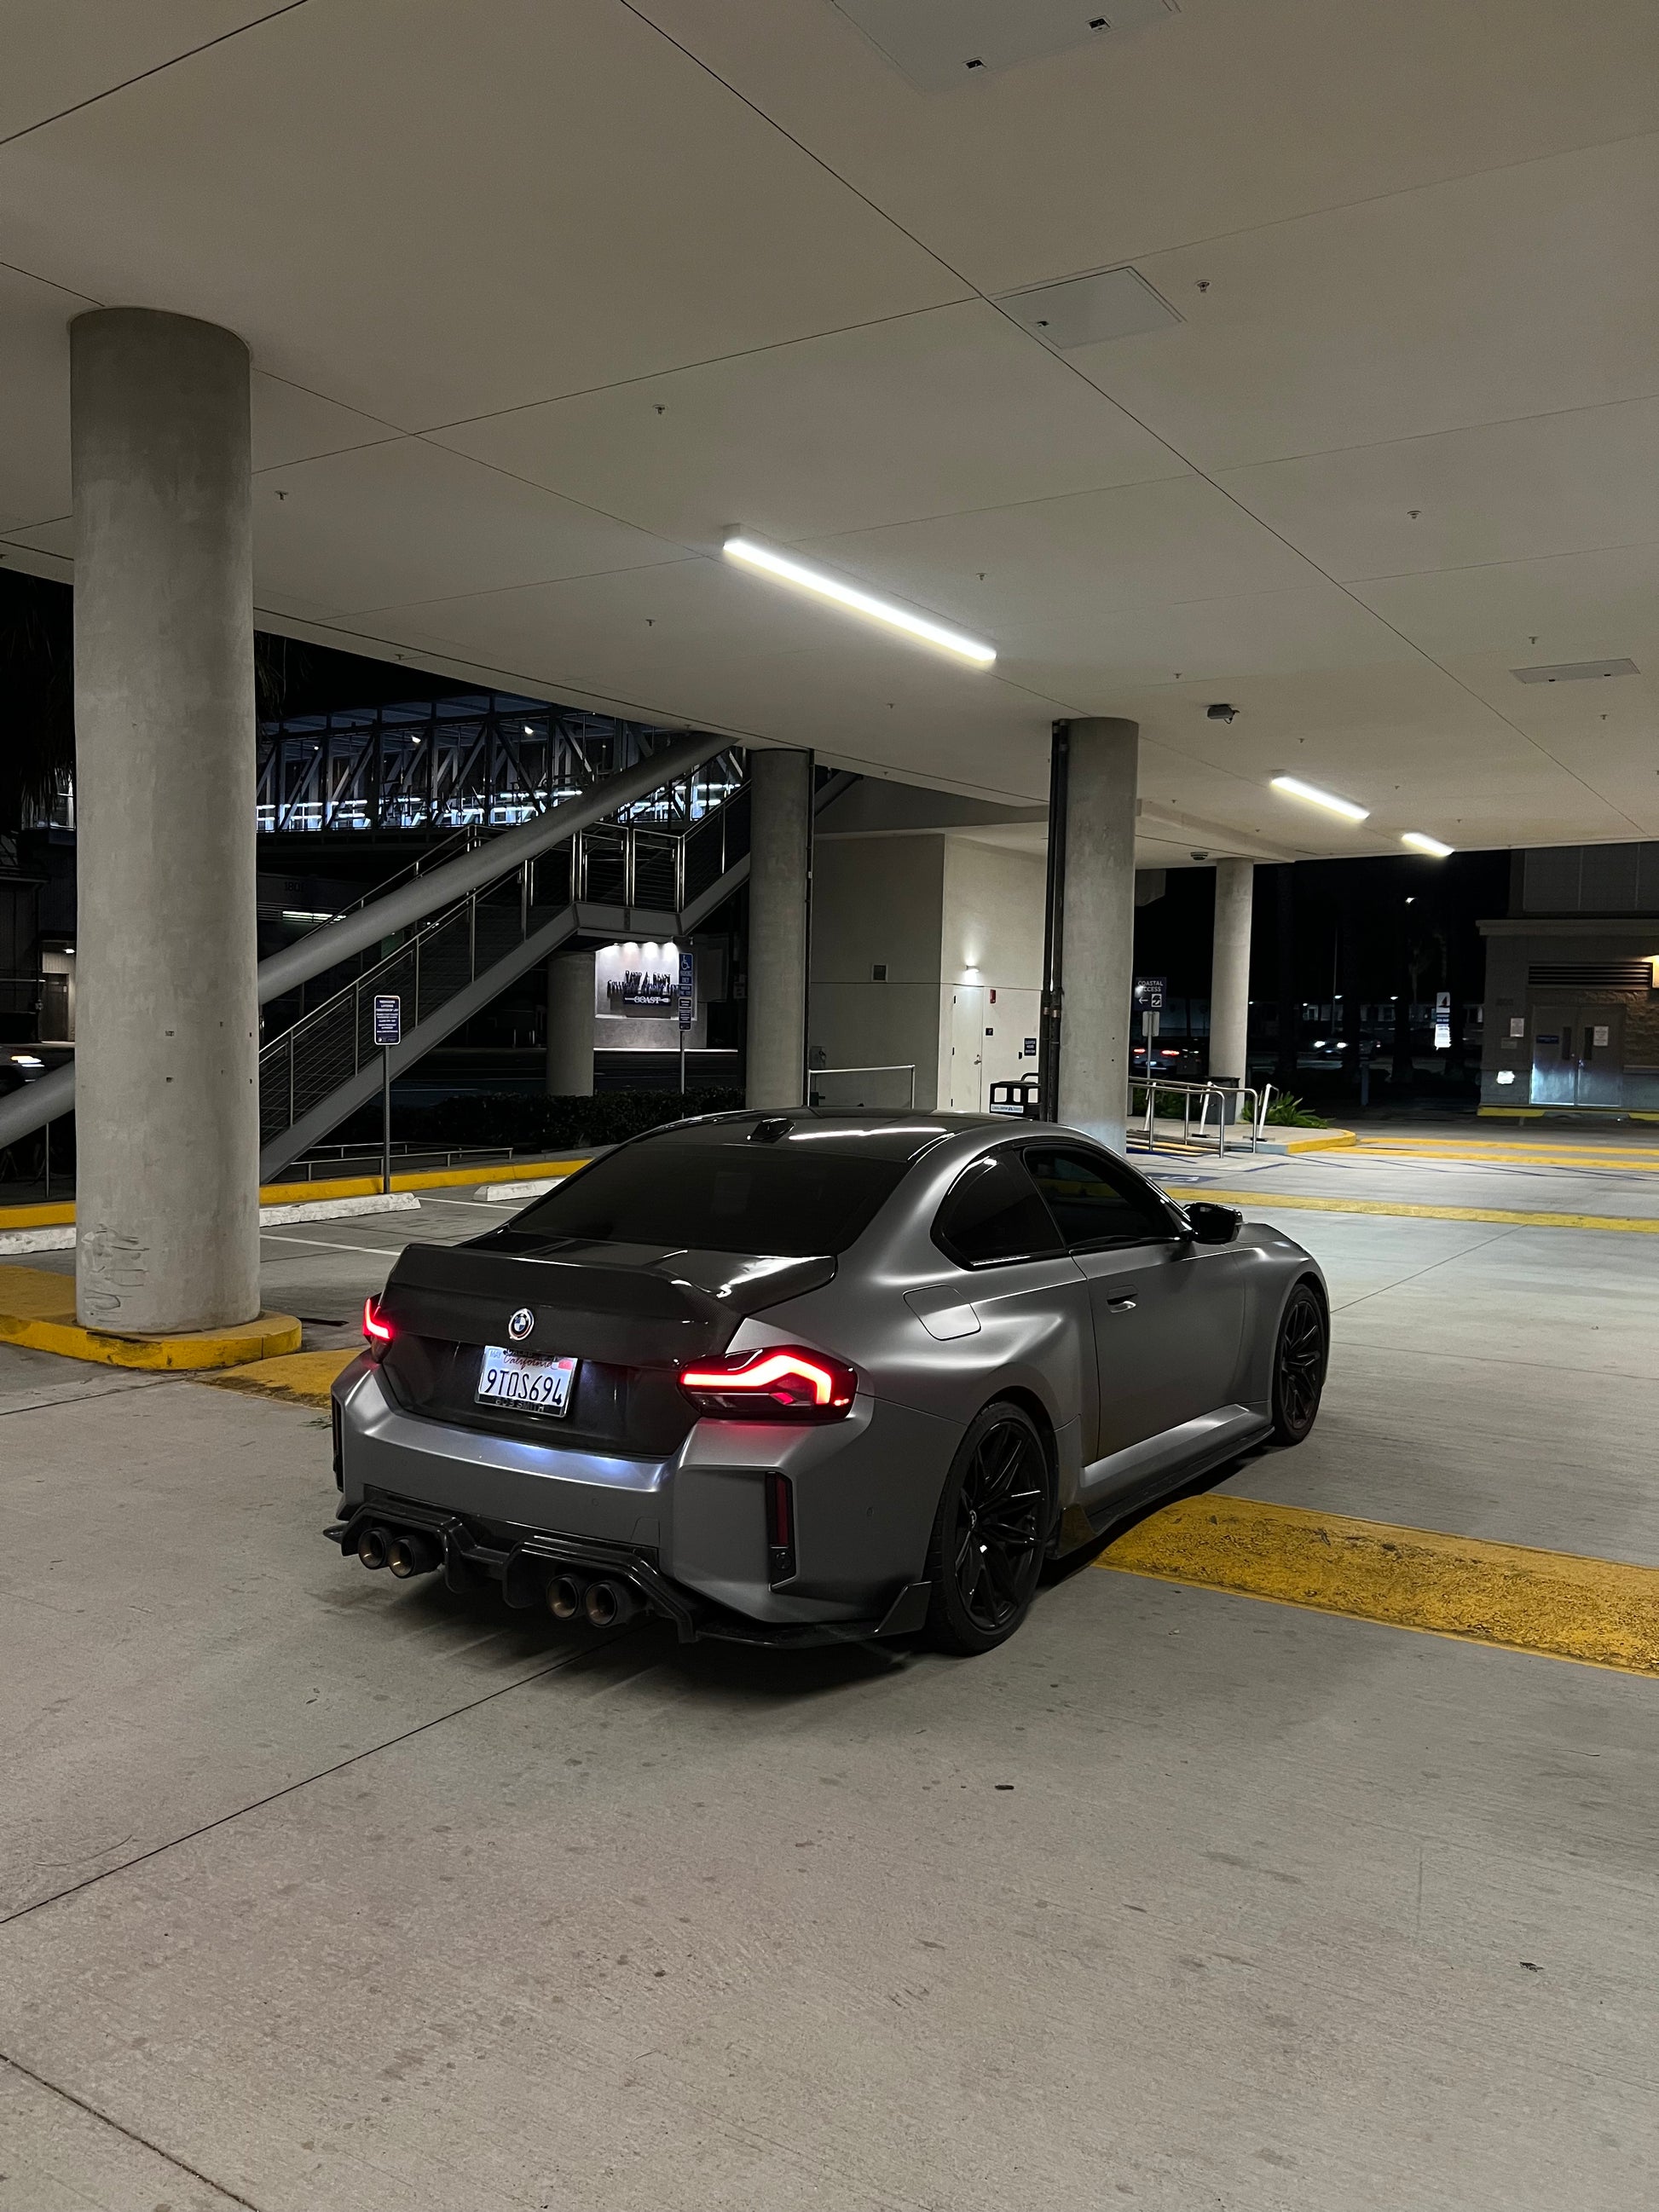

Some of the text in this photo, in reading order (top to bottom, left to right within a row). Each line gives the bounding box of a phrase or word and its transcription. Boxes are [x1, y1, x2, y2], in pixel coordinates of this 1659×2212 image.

[633, 996, 661, 1004] COAST
[503, 1354, 558, 1370] California
[484, 1369, 563, 1405] 9TOS694
